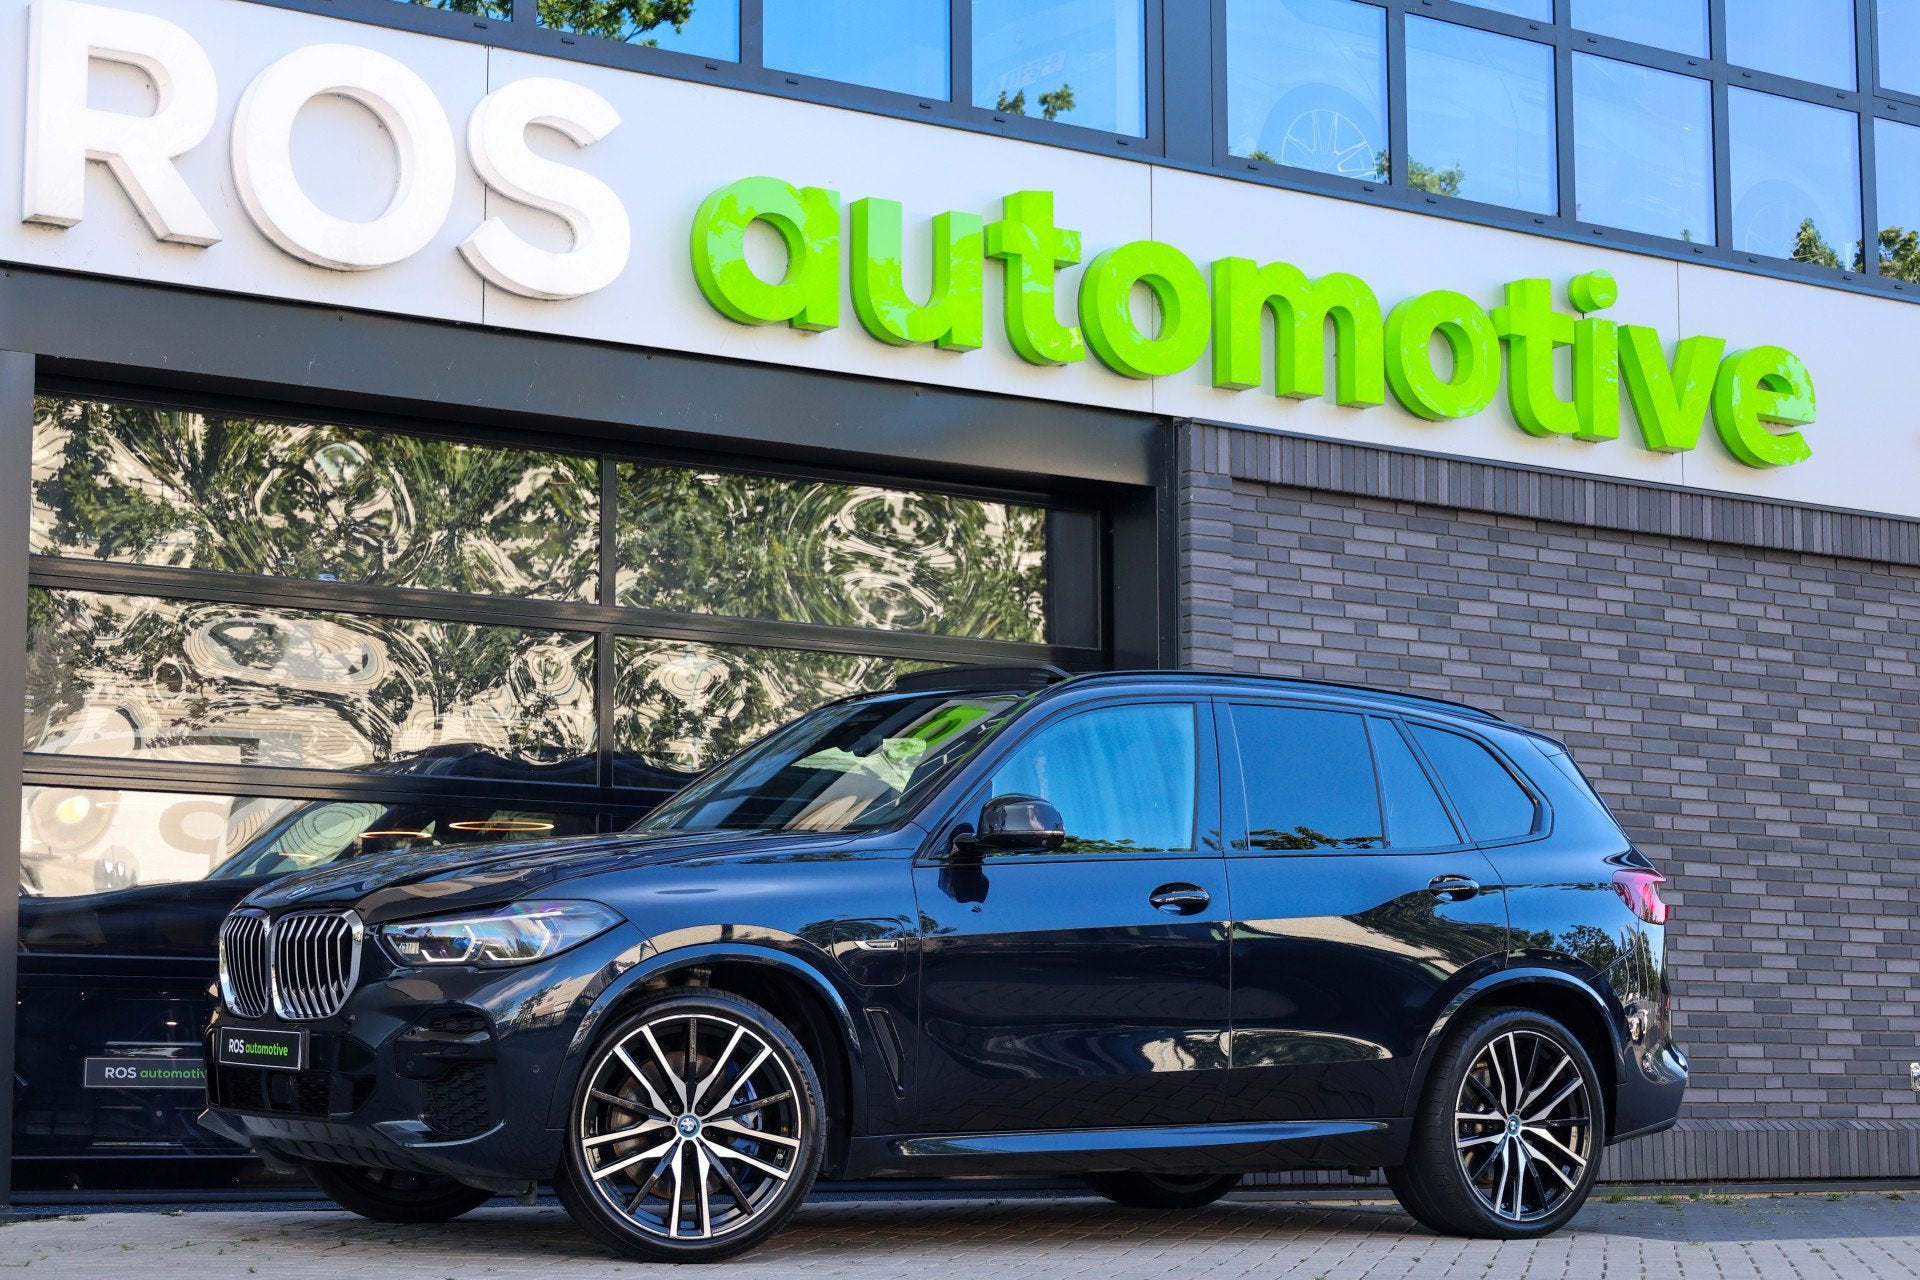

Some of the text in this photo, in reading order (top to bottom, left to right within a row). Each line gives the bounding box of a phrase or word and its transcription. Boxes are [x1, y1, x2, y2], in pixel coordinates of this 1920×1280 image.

[22, 2, 1816, 470] ROS automotive
[228, 1038, 289, 1056] ROS automotive
[104, 1066, 137, 1078] ROS
